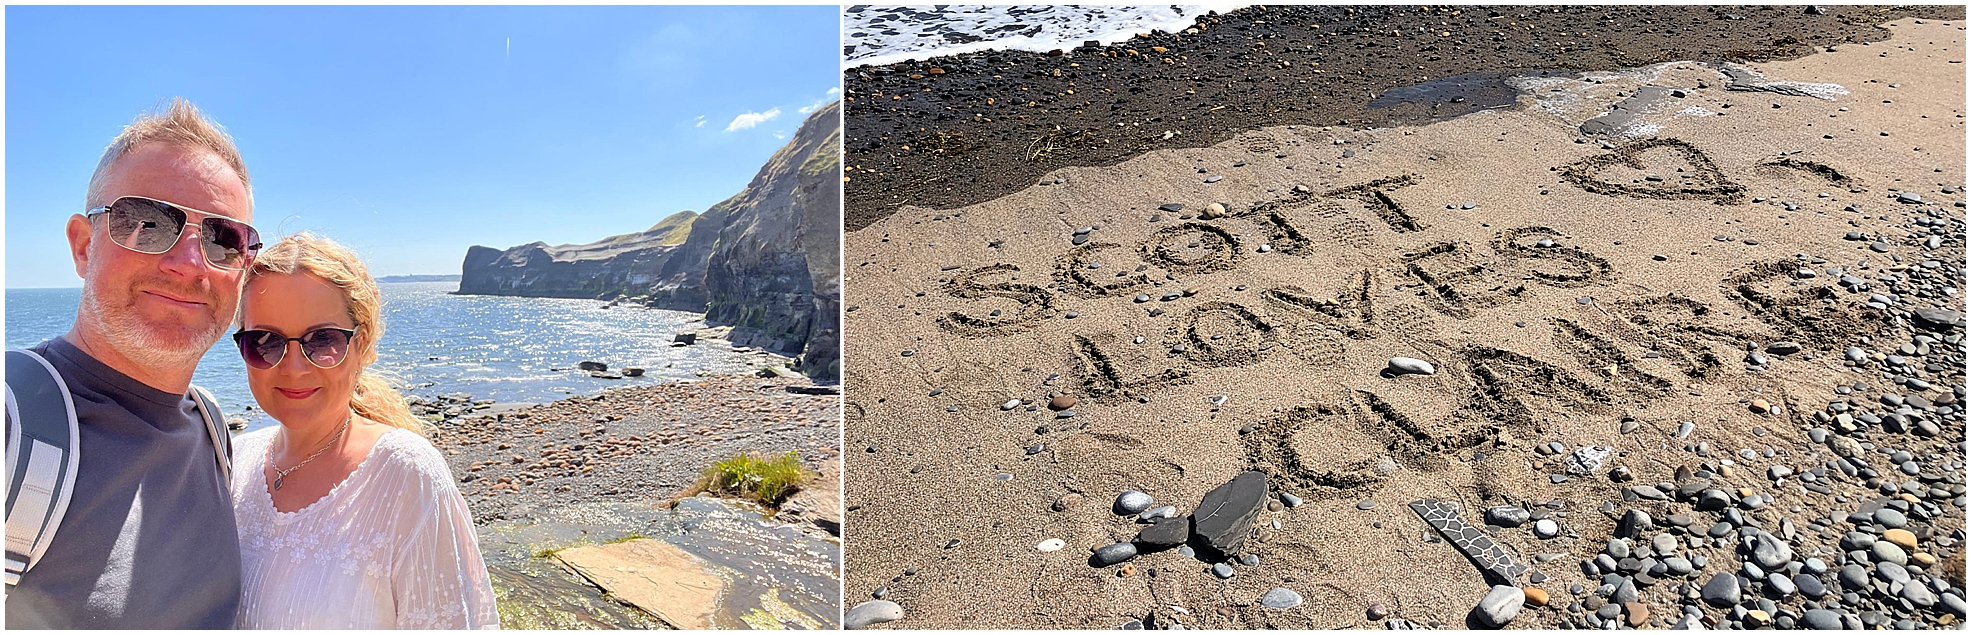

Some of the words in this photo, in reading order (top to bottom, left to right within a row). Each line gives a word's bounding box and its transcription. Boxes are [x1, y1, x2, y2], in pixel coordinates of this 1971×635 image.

[936, 173, 1426, 336] SCOTT
[1069, 226, 1614, 403] LOVES
[1242, 258, 1890, 498] CLAIRE
